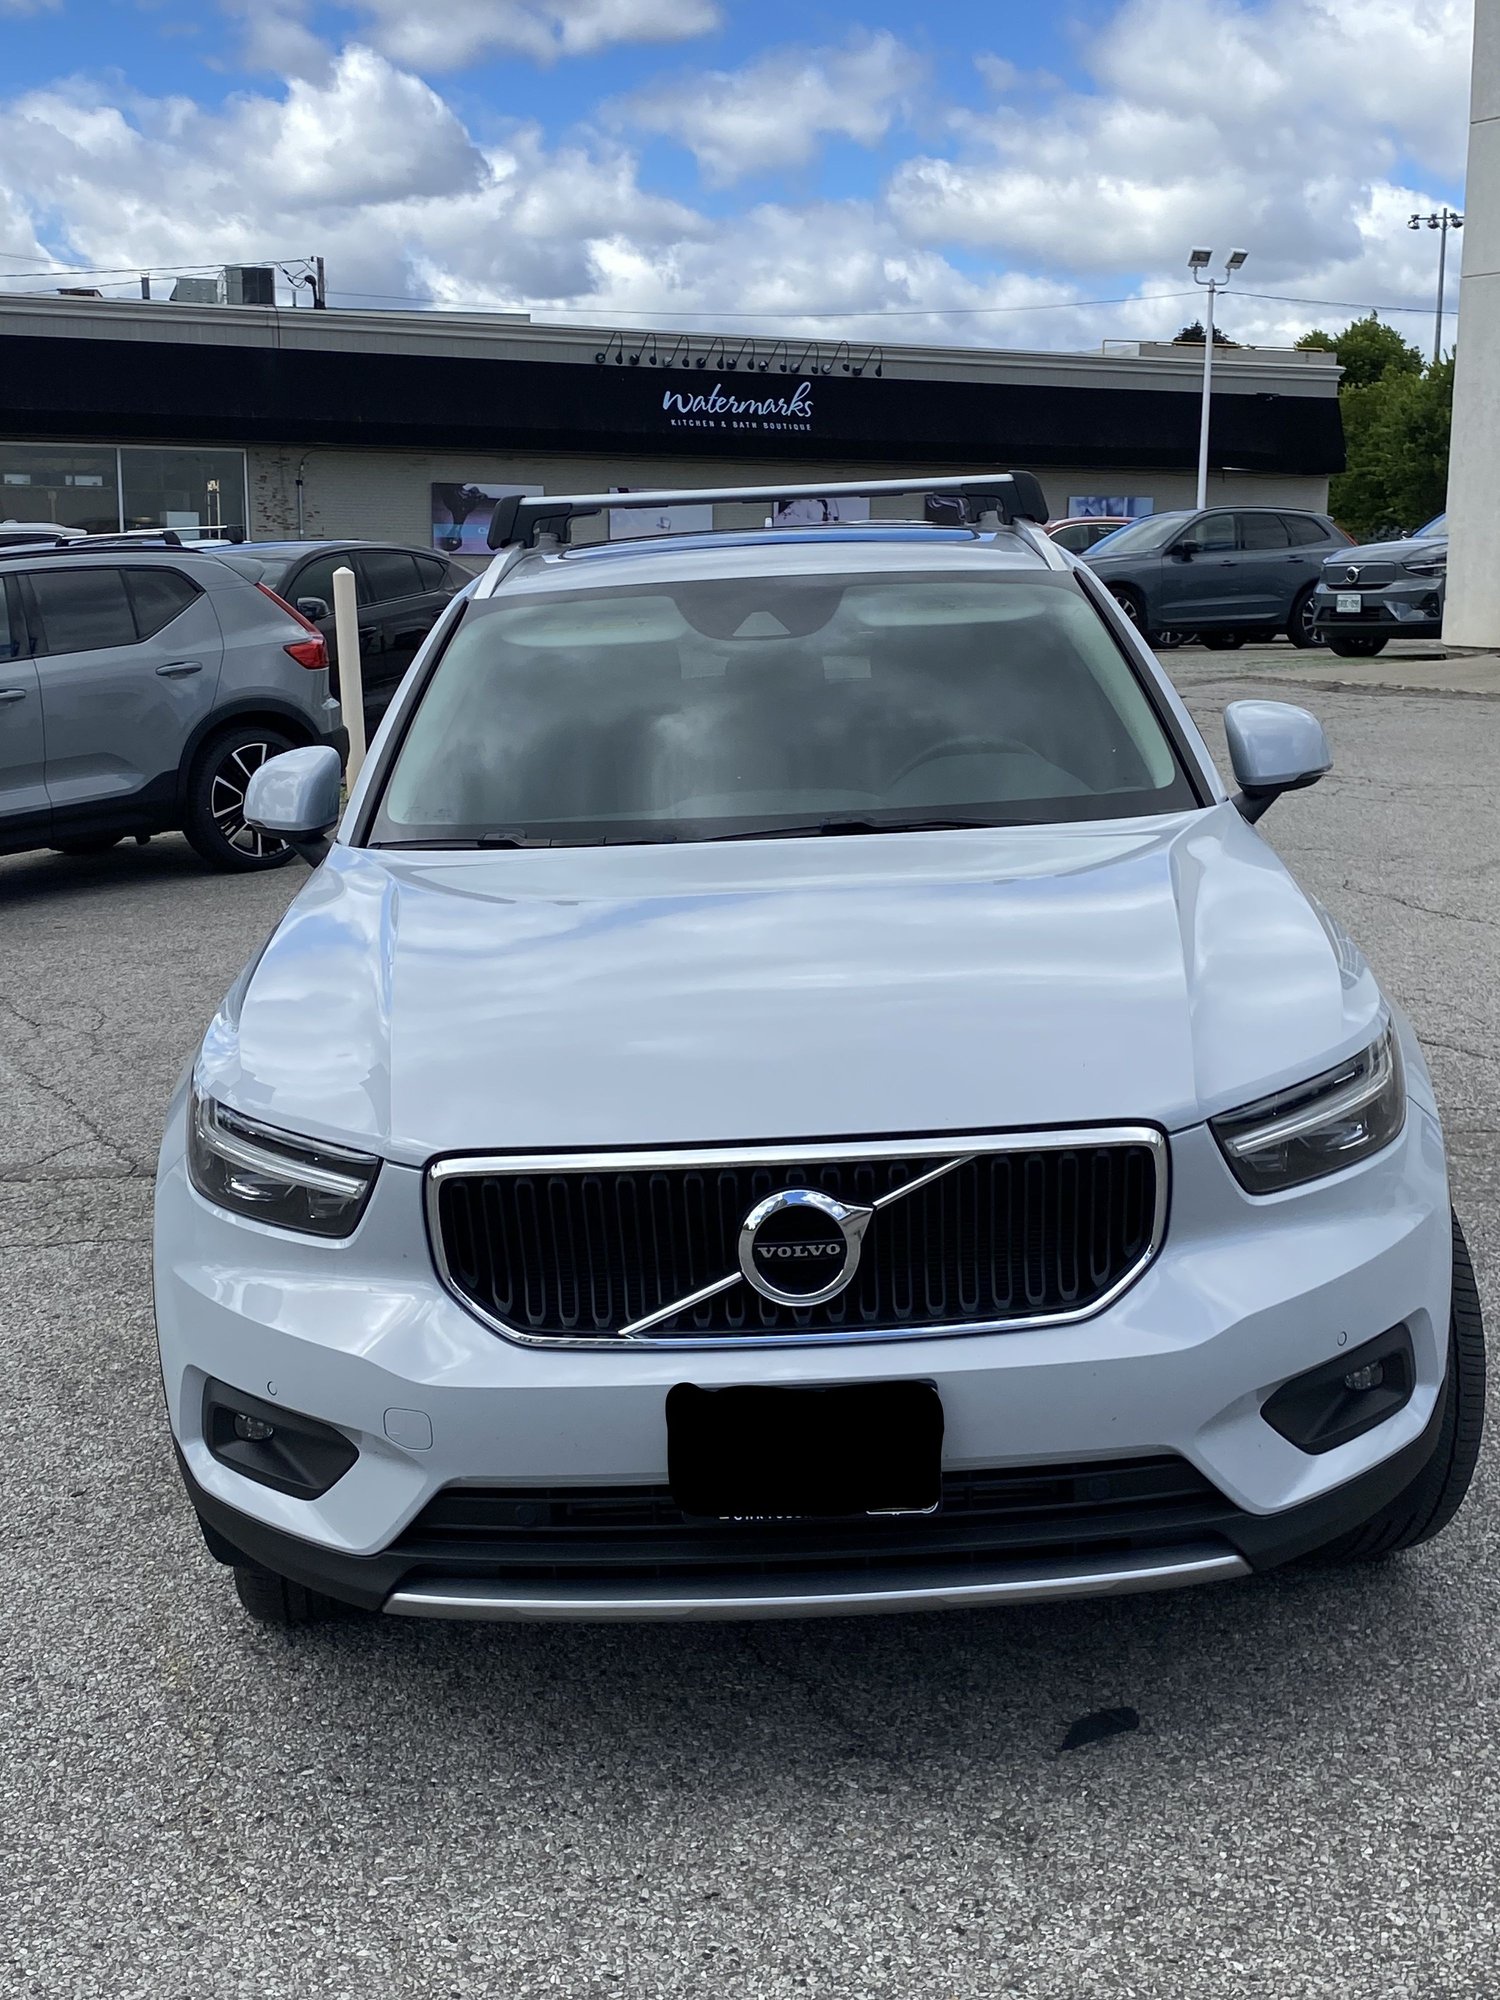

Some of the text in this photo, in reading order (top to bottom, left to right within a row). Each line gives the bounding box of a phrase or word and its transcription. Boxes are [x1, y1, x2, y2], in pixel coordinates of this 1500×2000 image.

[671, 419, 715, 427] KITCHEN
[733, 421, 758, 429] BATH
[763, 422, 812, 431] BOUTIQUE
[757, 1244, 840, 1258] VOLVO
